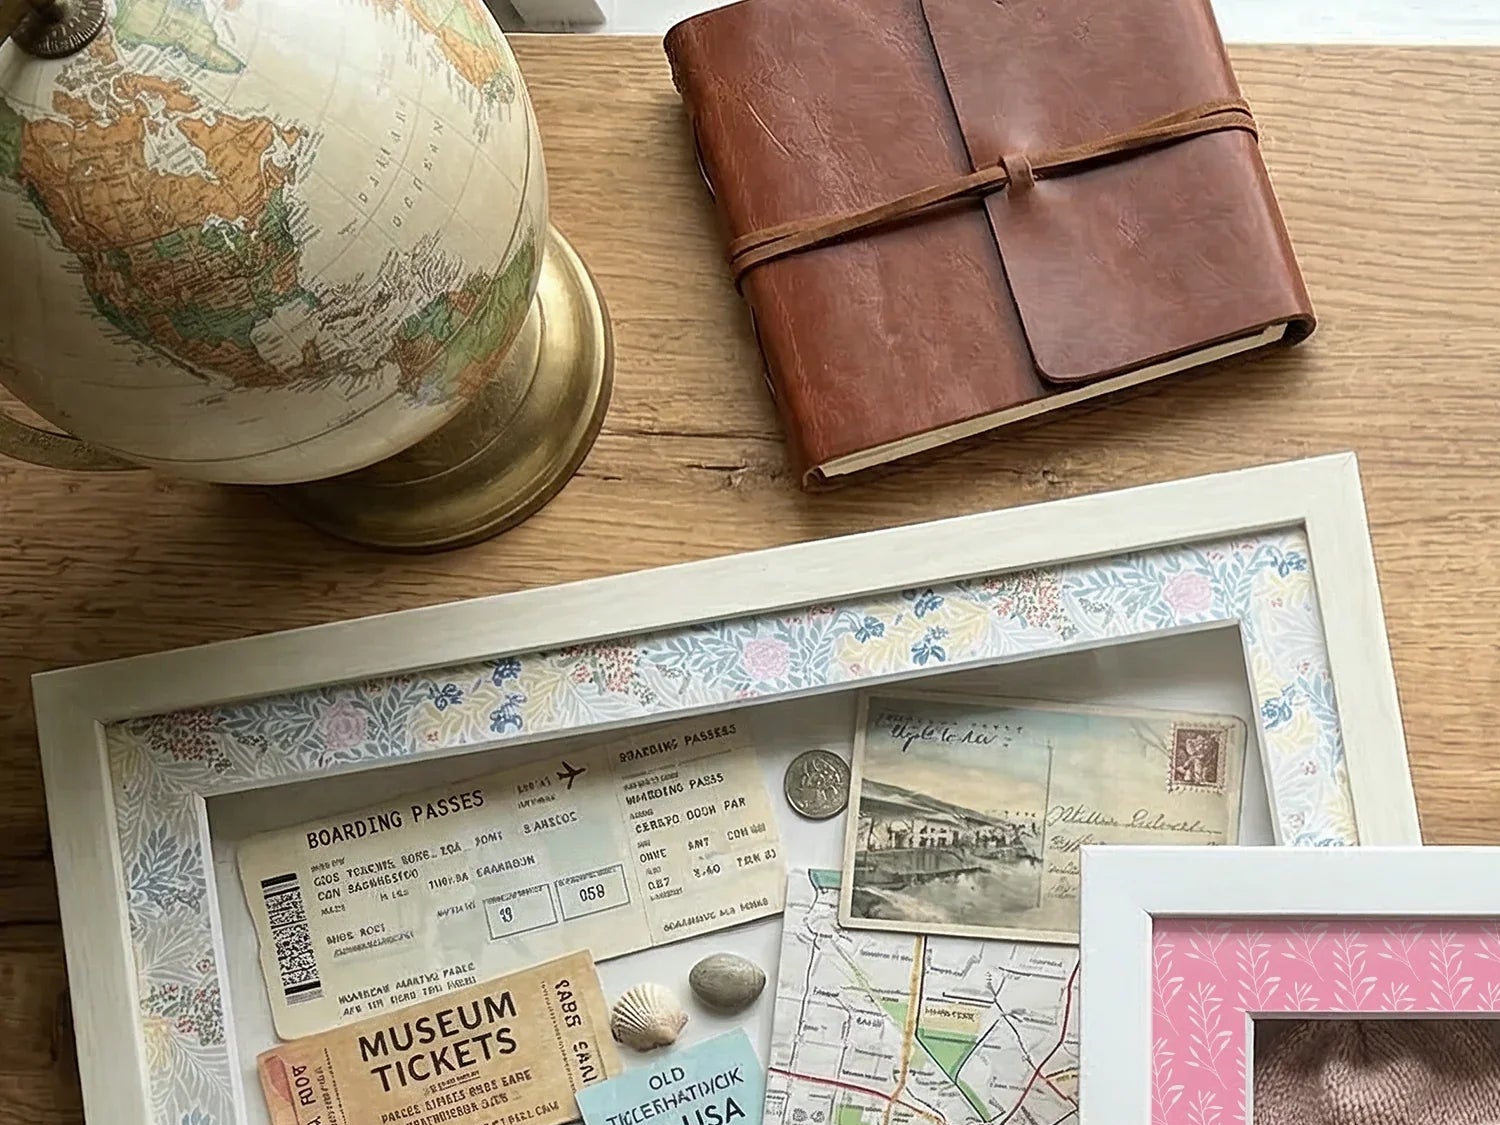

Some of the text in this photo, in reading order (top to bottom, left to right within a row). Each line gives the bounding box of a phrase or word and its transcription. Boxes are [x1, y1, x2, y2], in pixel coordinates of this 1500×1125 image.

[306, 811, 402, 849] BOARDING
[411, 789, 485, 823] PASSES
[357, 990, 518, 1063] MUSEUM
[369, 1027, 518, 1093] TICKETS
[649, 1065, 686, 1092] OLD
